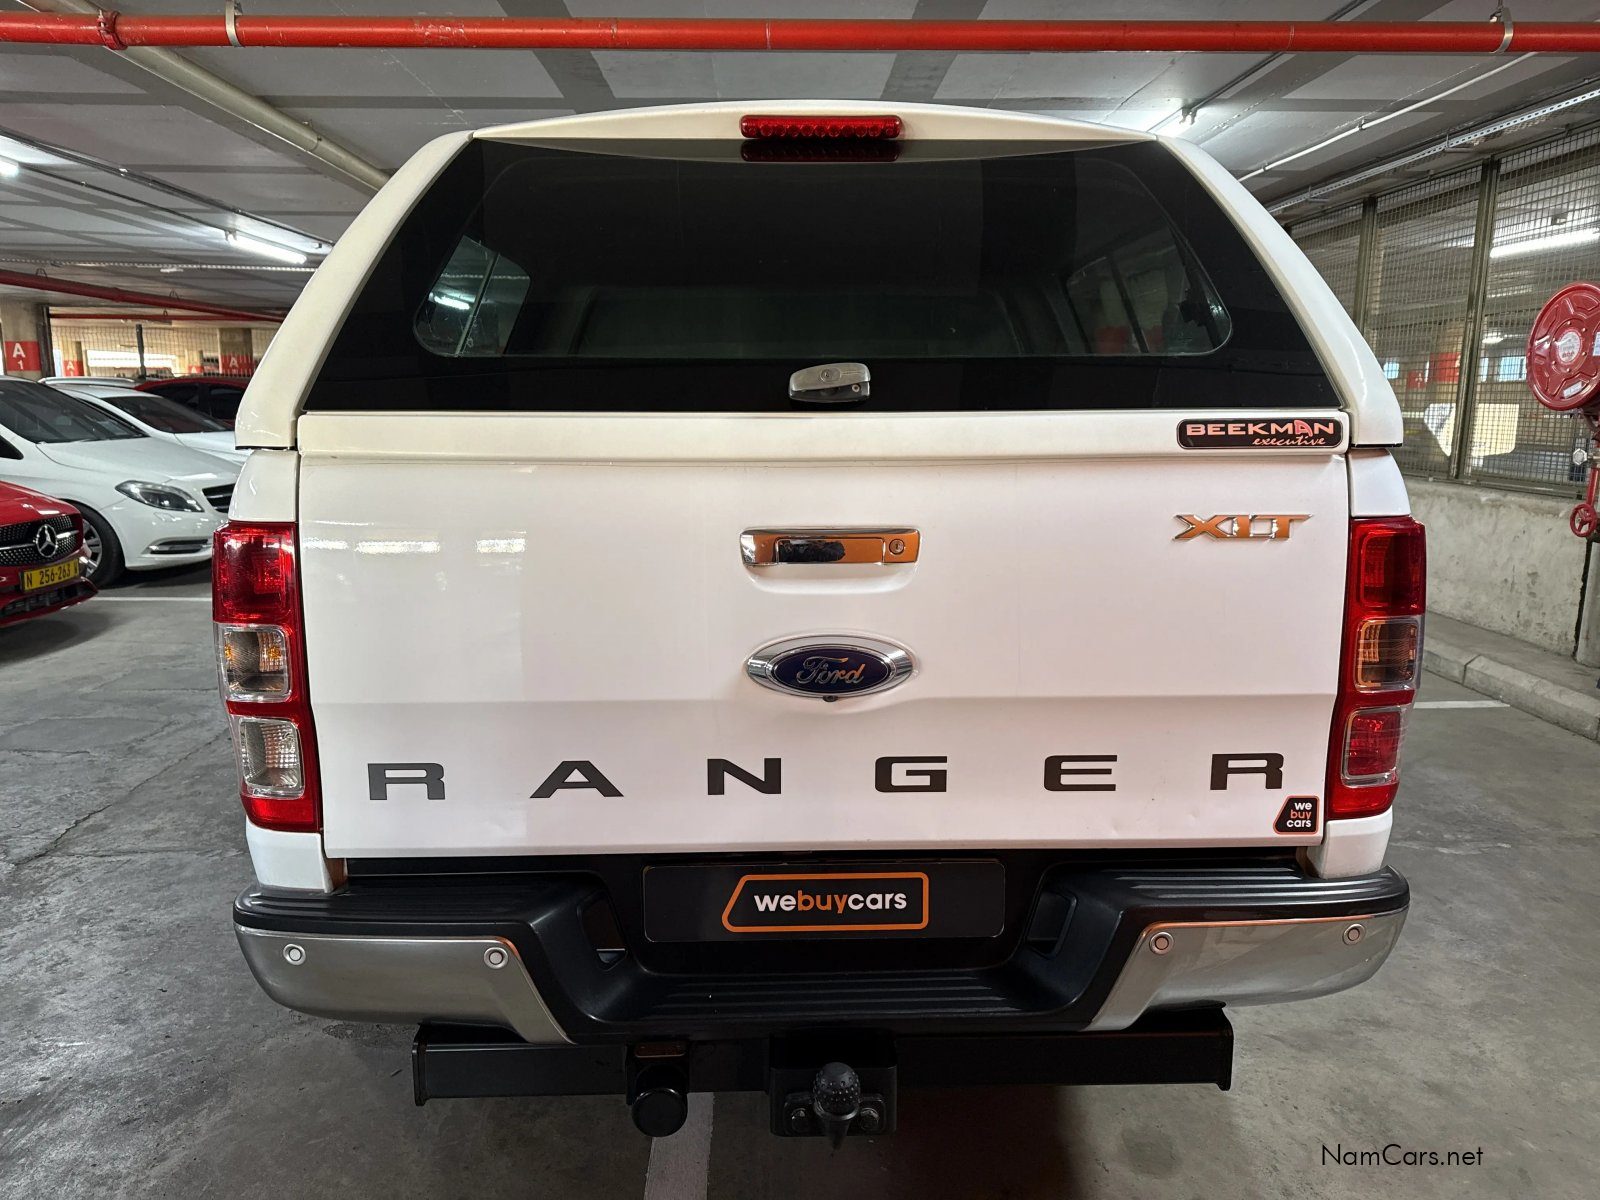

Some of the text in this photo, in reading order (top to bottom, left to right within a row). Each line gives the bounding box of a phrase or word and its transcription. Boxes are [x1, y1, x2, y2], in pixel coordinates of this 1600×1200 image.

[12, 343, 26, 358] A
[17, 359, 24, 370] 1
[1186, 419, 1335, 437] BEEKMAN
[1252, 436, 1326, 446] executive
[1174, 514, 1314, 539] XLT
[26, 573, 33, 588] N
[796, 655, 866, 684] Ford
[367, 752, 1285, 802] RANGER
[1294, 802, 1312, 810] we
[1290, 809, 1312, 819] buy
[1286, 819, 1311, 828] cars
[754, 890, 907, 914] webuycars
